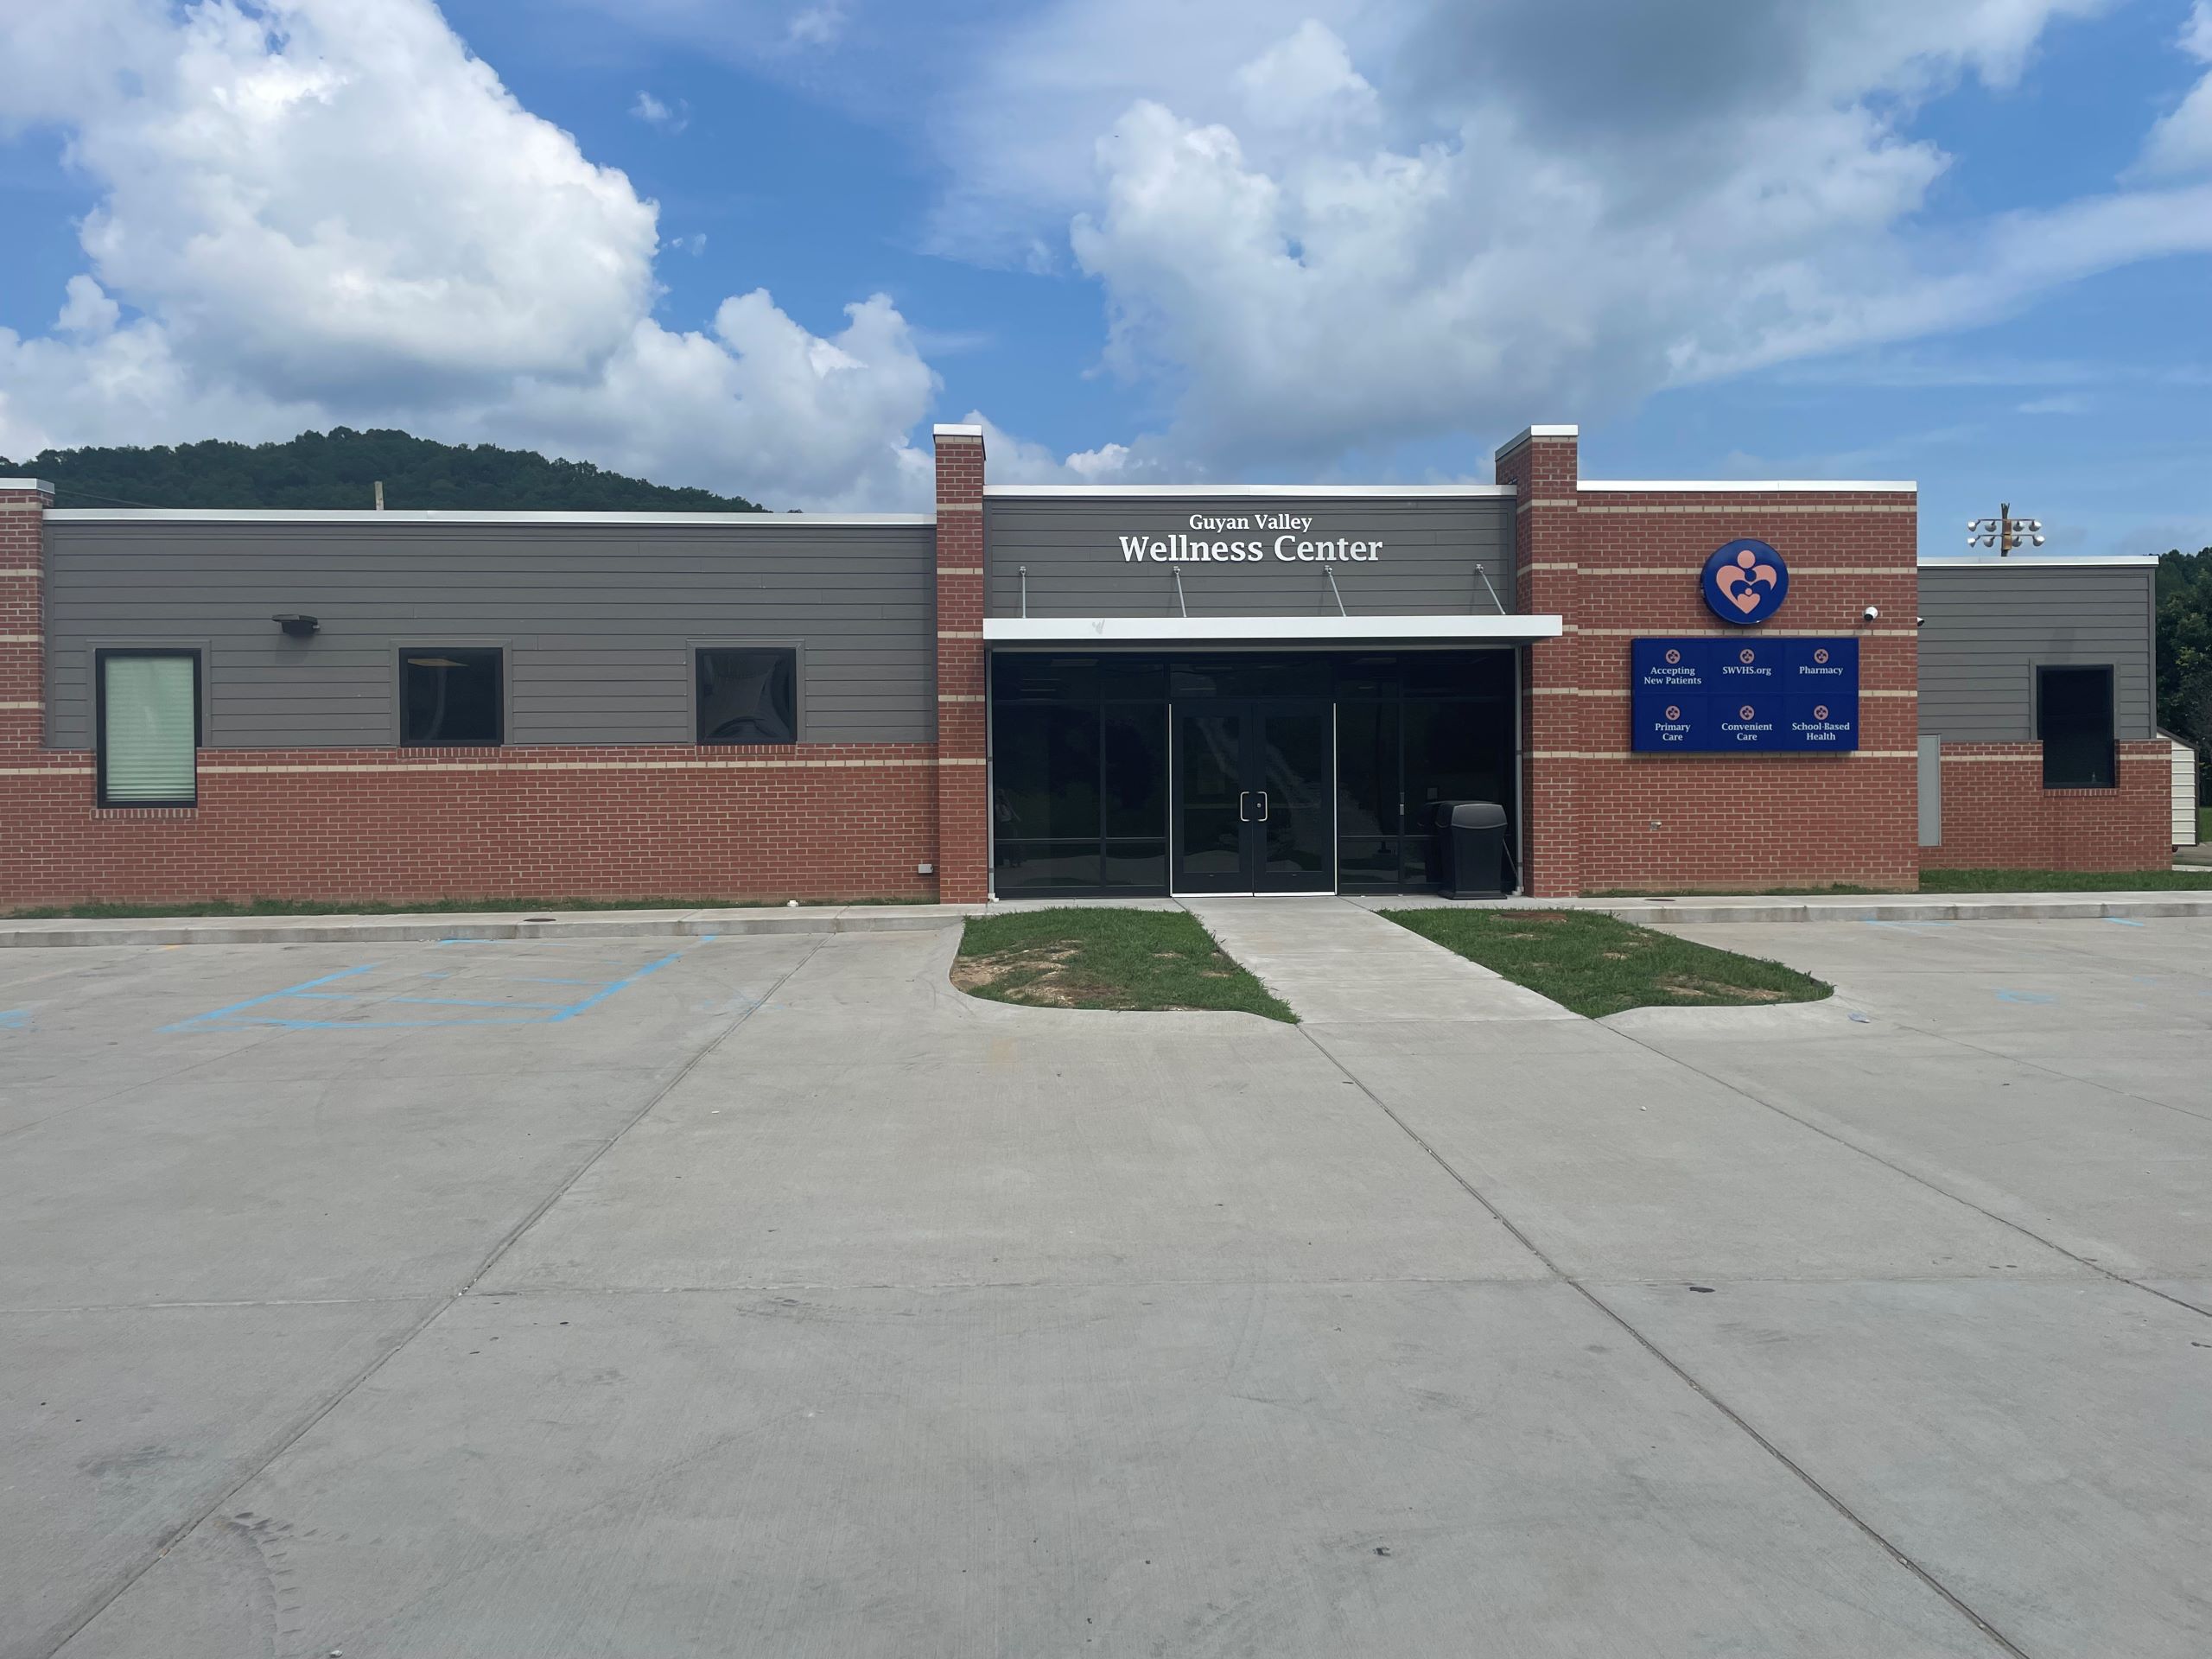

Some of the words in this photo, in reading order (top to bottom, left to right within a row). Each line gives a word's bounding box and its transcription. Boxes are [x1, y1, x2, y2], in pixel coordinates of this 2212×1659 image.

[1189, 514, 1250, 533] Guyan
[1254, 513, 1313, 533] Valley
[1118, 534, 1264, 562] Wellness
[1274, 535, 1383, 562] Center
[1650, 666, 1695, 677] Accepting
[1722, 666, 1772, 677] SWVHS.org
[1799, 665, 1844, 676] Pharmacy
[1643, 676, 1664, 685] New
[1666, 677, 1702, 685] Patients
[1655, 722, 1691, 733] Primary
[1721, 722, 1773, 731] Convenient
[1791, 721, 1850, 731] School-Based
[1662, 733, 1683, 741] Care
[1736, 732, 1758, 741] Care
[1806, 732, 1836, 741] Health
